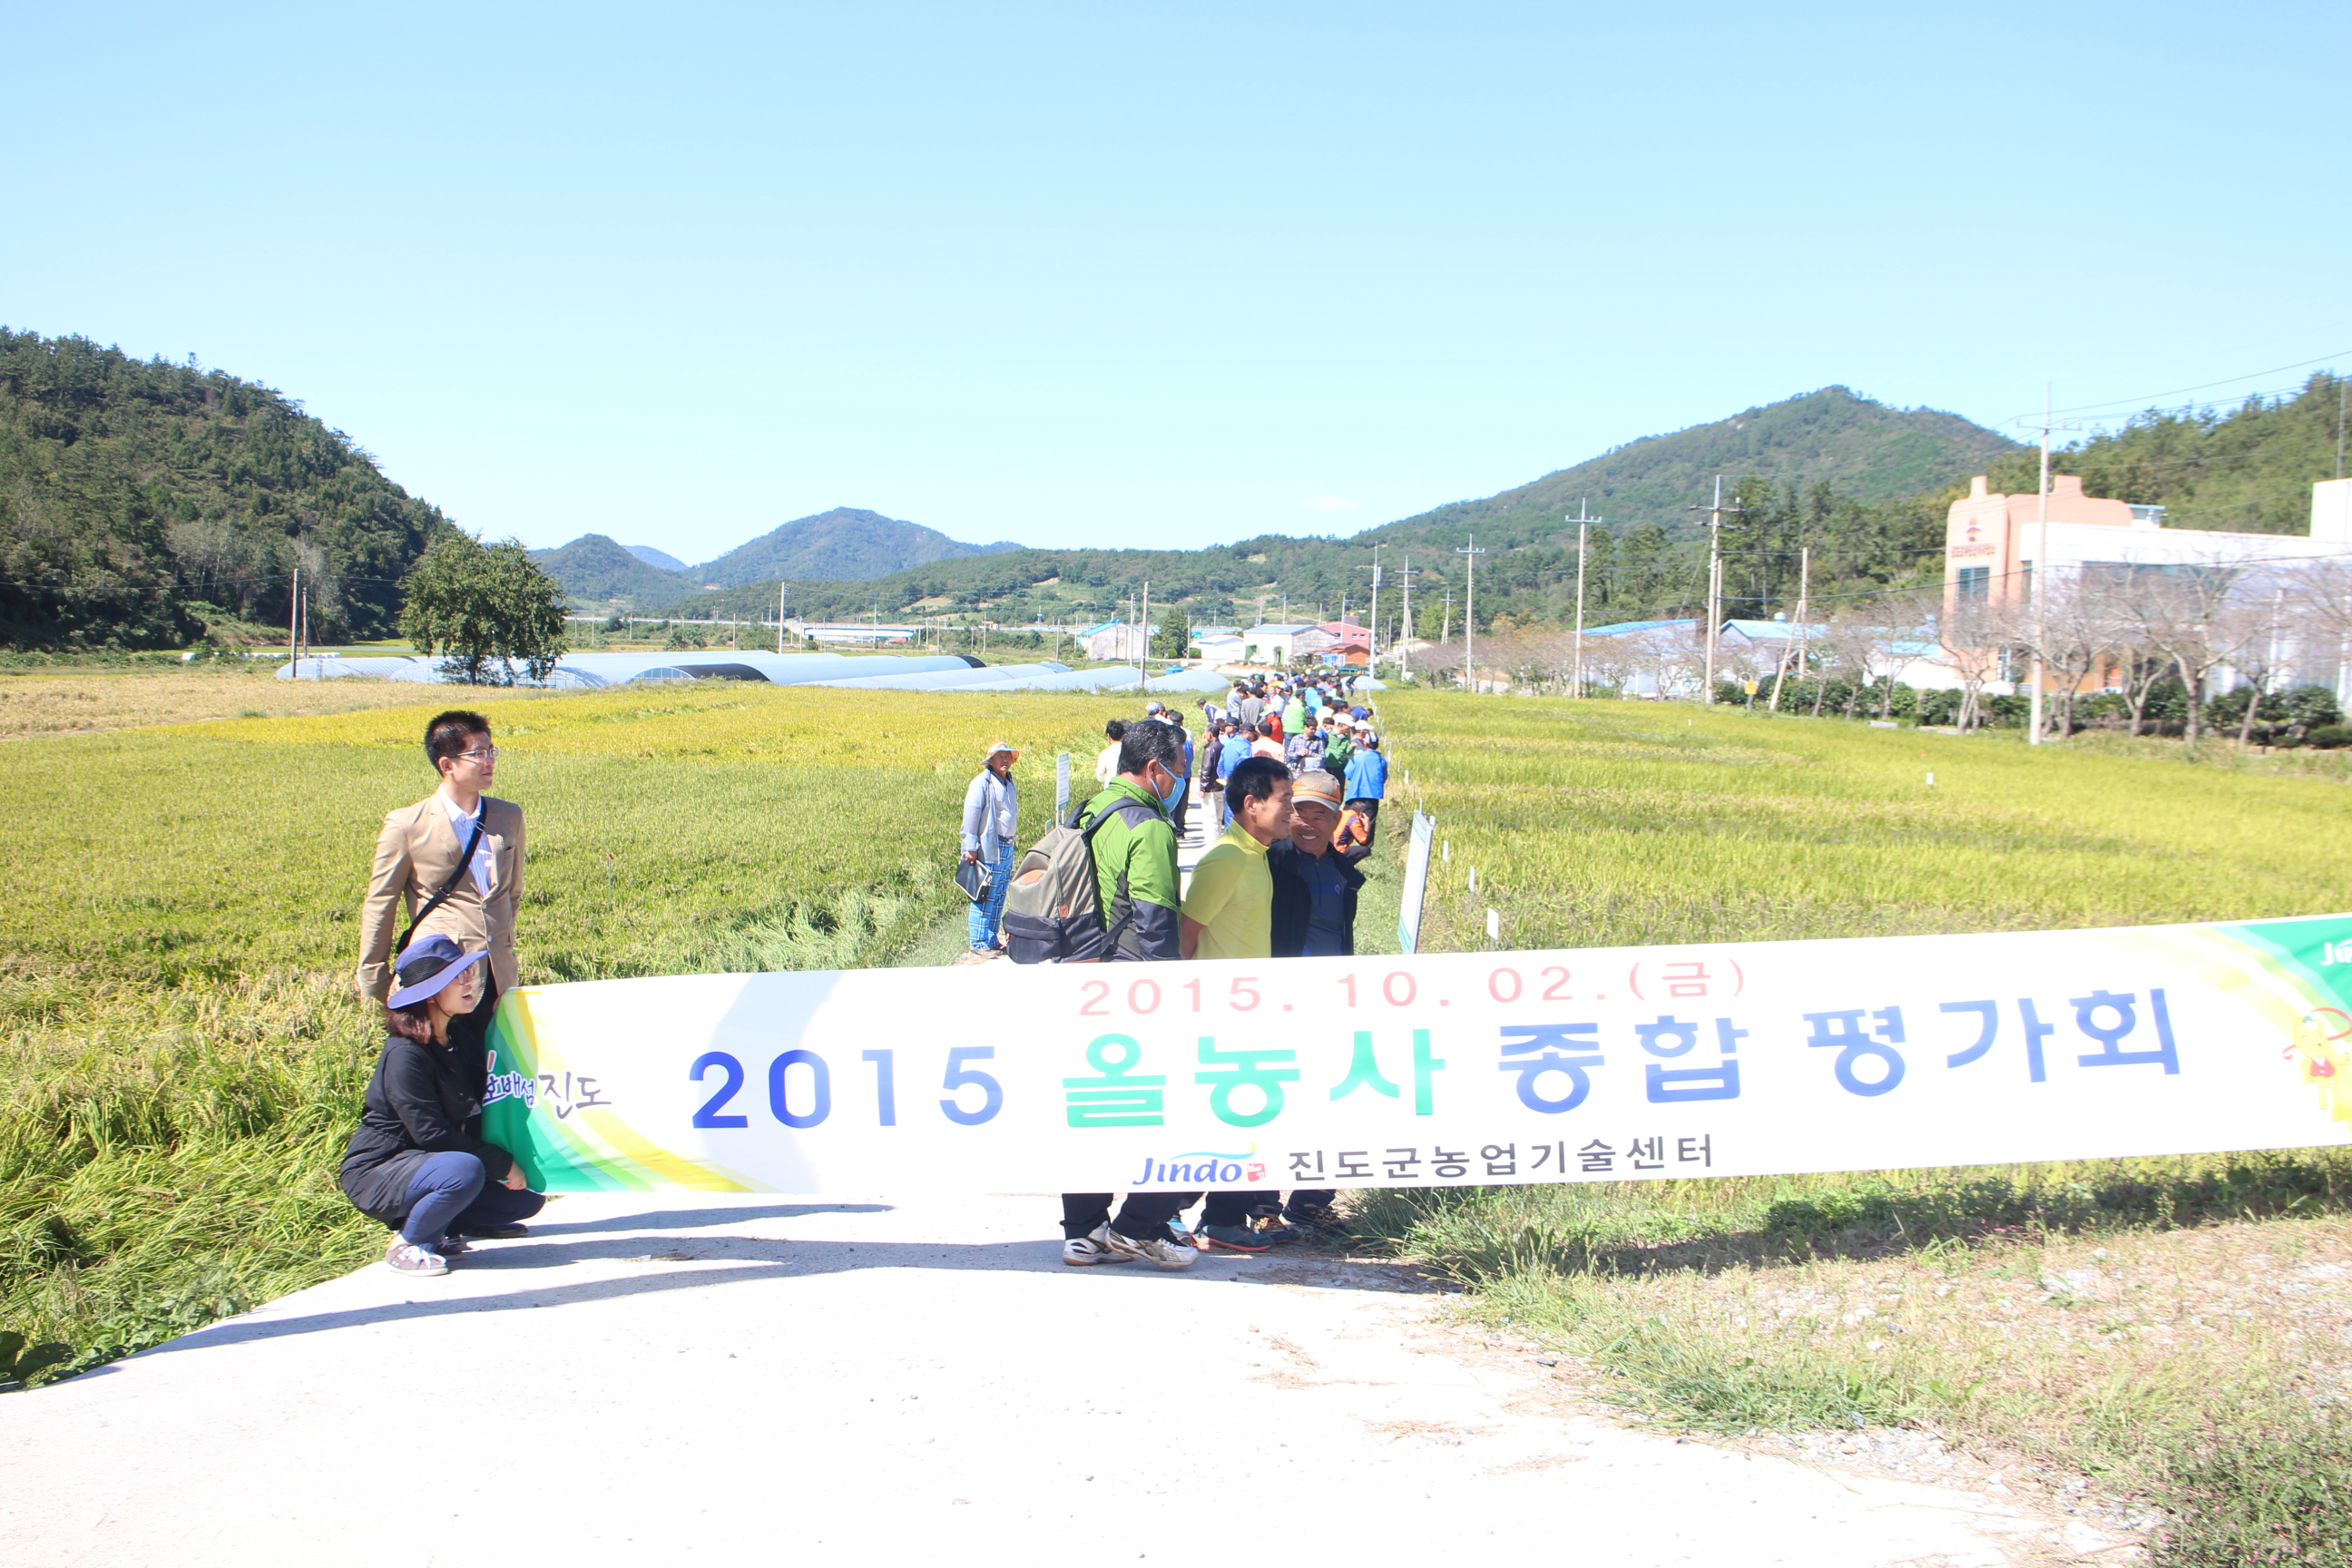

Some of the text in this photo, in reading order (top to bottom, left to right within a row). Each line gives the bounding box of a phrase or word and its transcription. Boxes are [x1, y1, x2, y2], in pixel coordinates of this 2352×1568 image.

[1079, 959, 1745, 1016] 2015. 10. 02.(금)
[690, 988, 2180, 1130] 2015 올농사 종합 평가회
[538, 1070, 612, 1120] 진도
[1132, 1158, 1242, 1185] Jindo
[1288, 1133, 1714, 1181] 진도군농업기술센터
